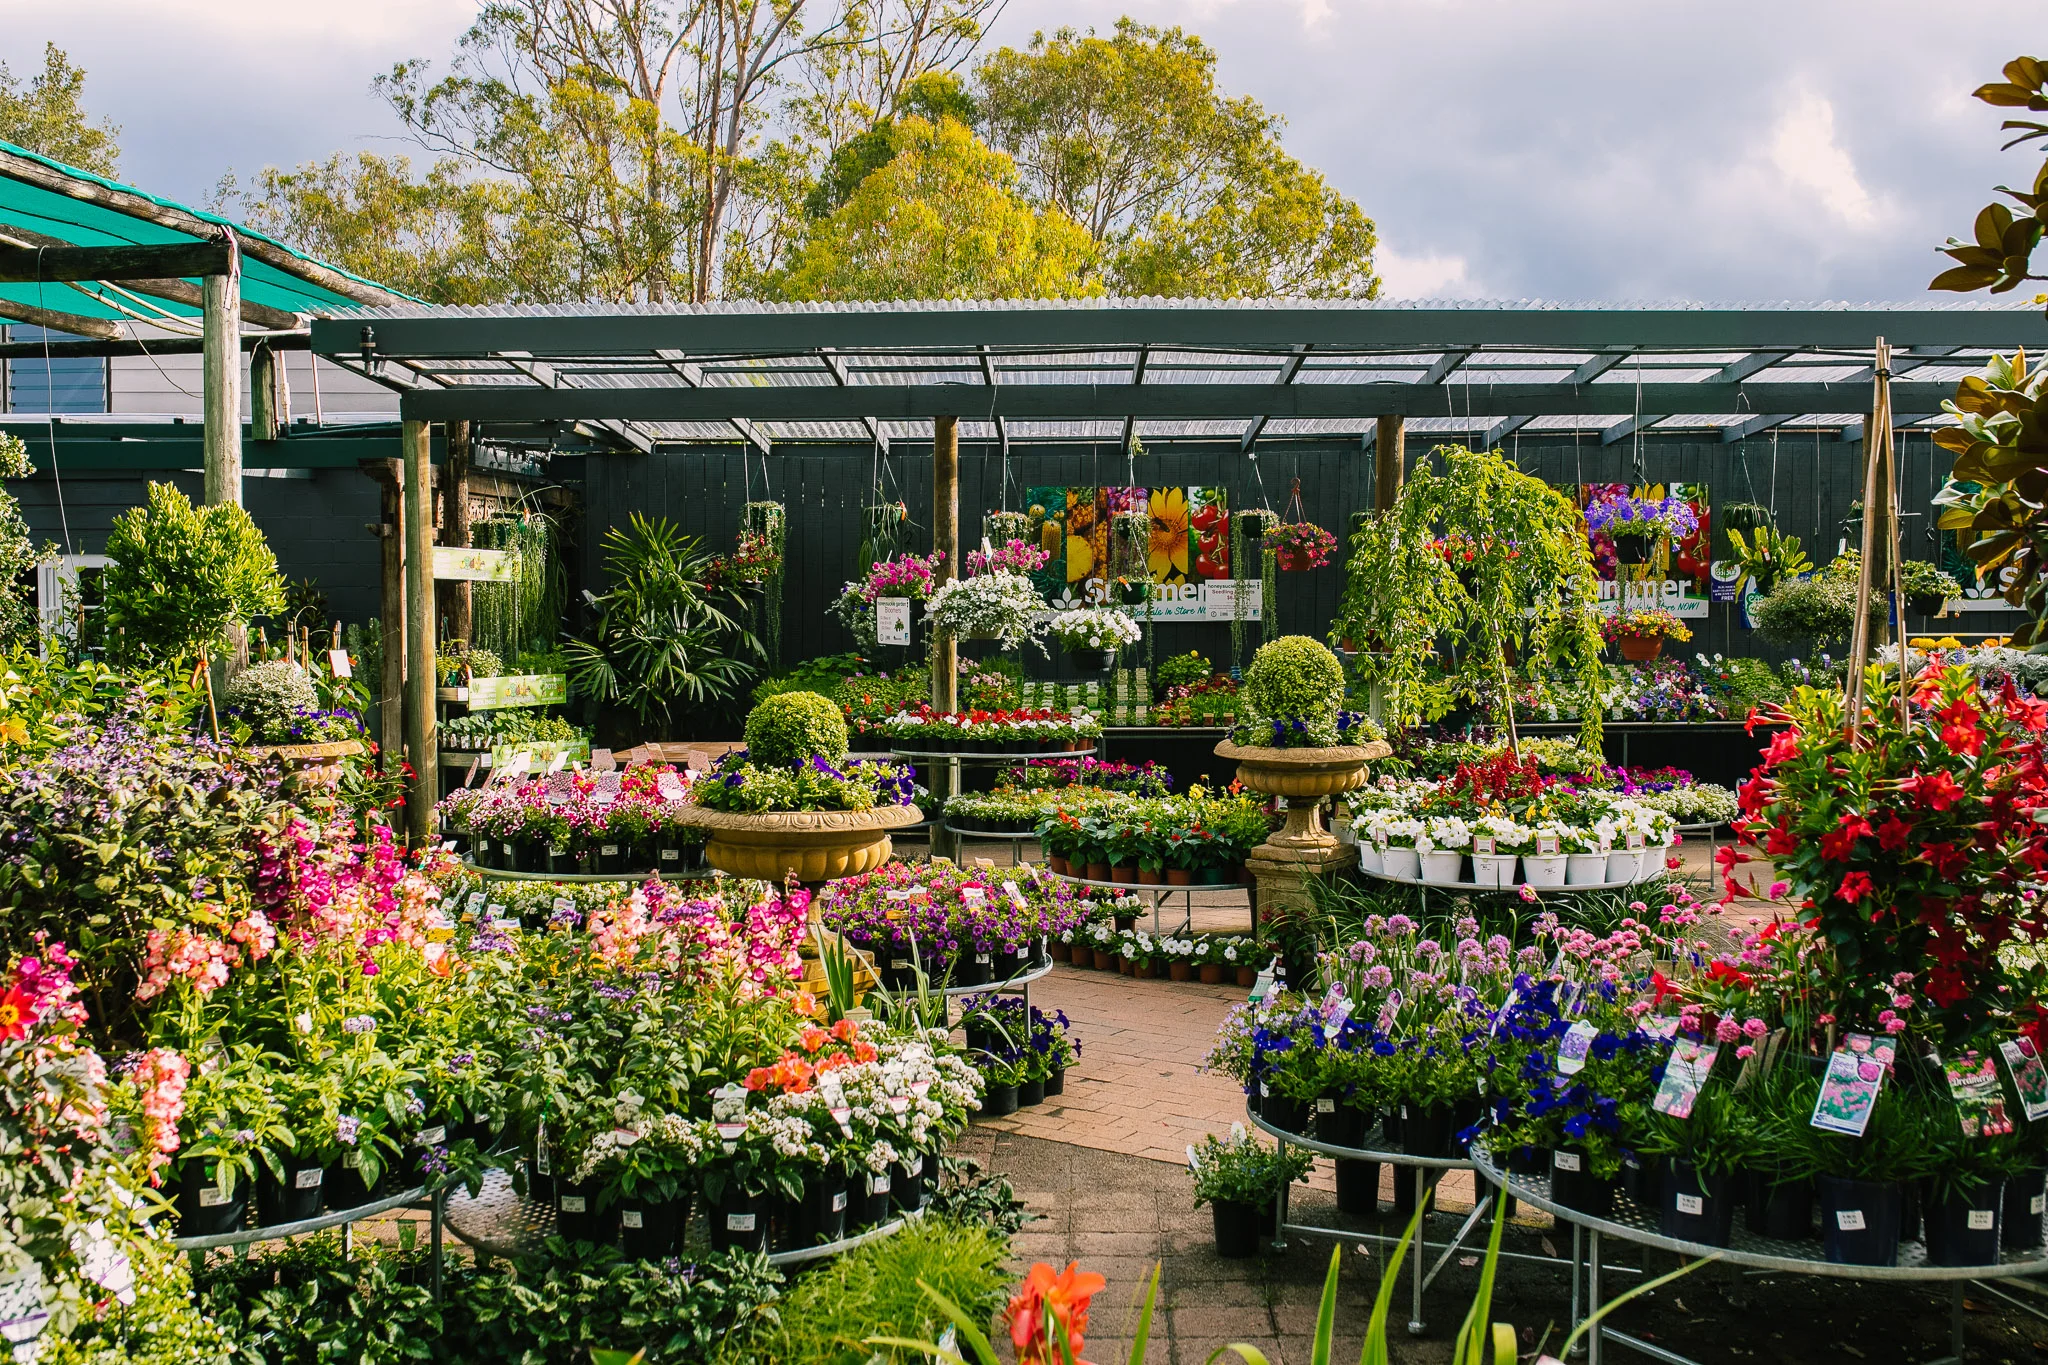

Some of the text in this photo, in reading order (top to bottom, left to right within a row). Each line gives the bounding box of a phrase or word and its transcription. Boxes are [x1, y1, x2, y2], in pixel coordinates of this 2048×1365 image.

[1085, 578, 1205, 603] Smer
[1566, 574, 1692, 600] Smmer
[1174, 605, 1196, 615] Store
[1677, 602, 1700, 611] NOW!
